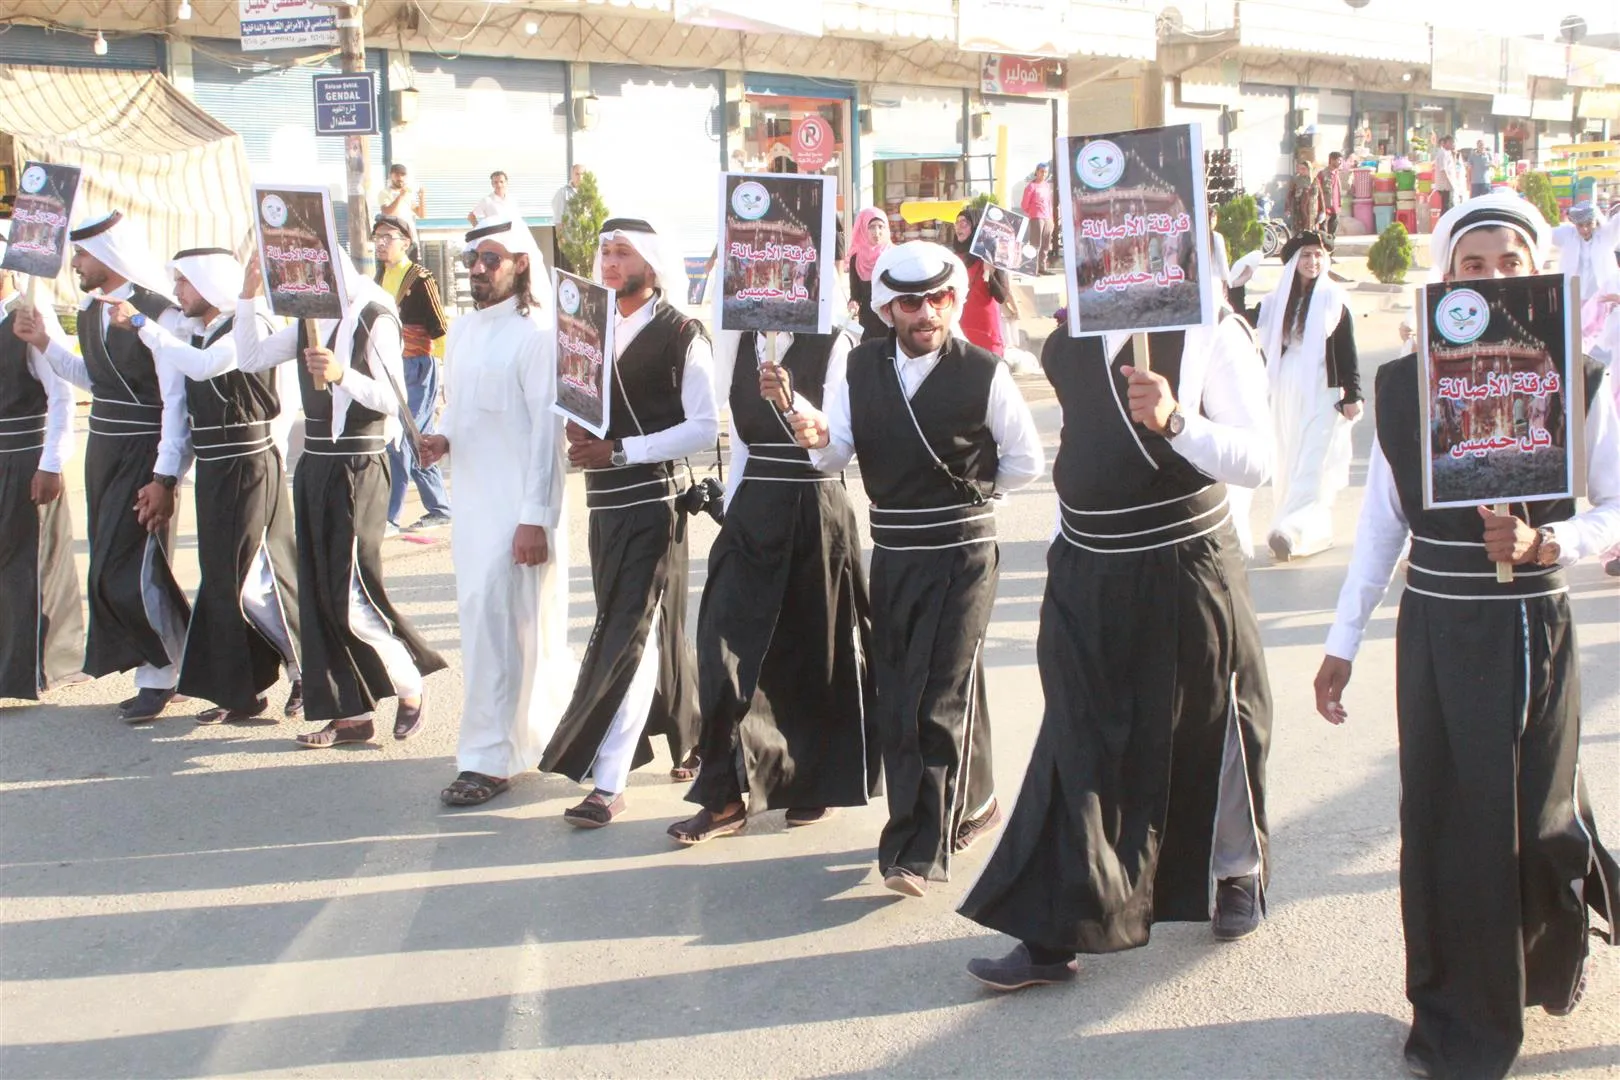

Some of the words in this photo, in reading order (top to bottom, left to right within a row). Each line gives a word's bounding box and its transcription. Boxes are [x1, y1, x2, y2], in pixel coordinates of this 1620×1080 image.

[1004, 63, 1038, 86] هولير
[325, 91, 361, 101] GENDAL
[1082, 214, 1145, 239] الأصالة
[1148, 213, 1190, 235] فرقة
[303, 247, 329, 262] فرقة
[731, 242, 781, 260] الأصالة
[784, 245, 816, 264] فرقة
[1095, 272, 1153, 291] حميس
[1155, 264, 1184, 288] تل
[312, 281, 329, 294] تل
[737, 287, 784, 300] حميس
[786, 284, 808, 301] تل
[1438, 371, 1509, 400] الأصالة
[1512, 370, 1560, 399] فرقة
[1452, 435, 1518, 458] حميس
[1520, 426, 1551, 452] تل
